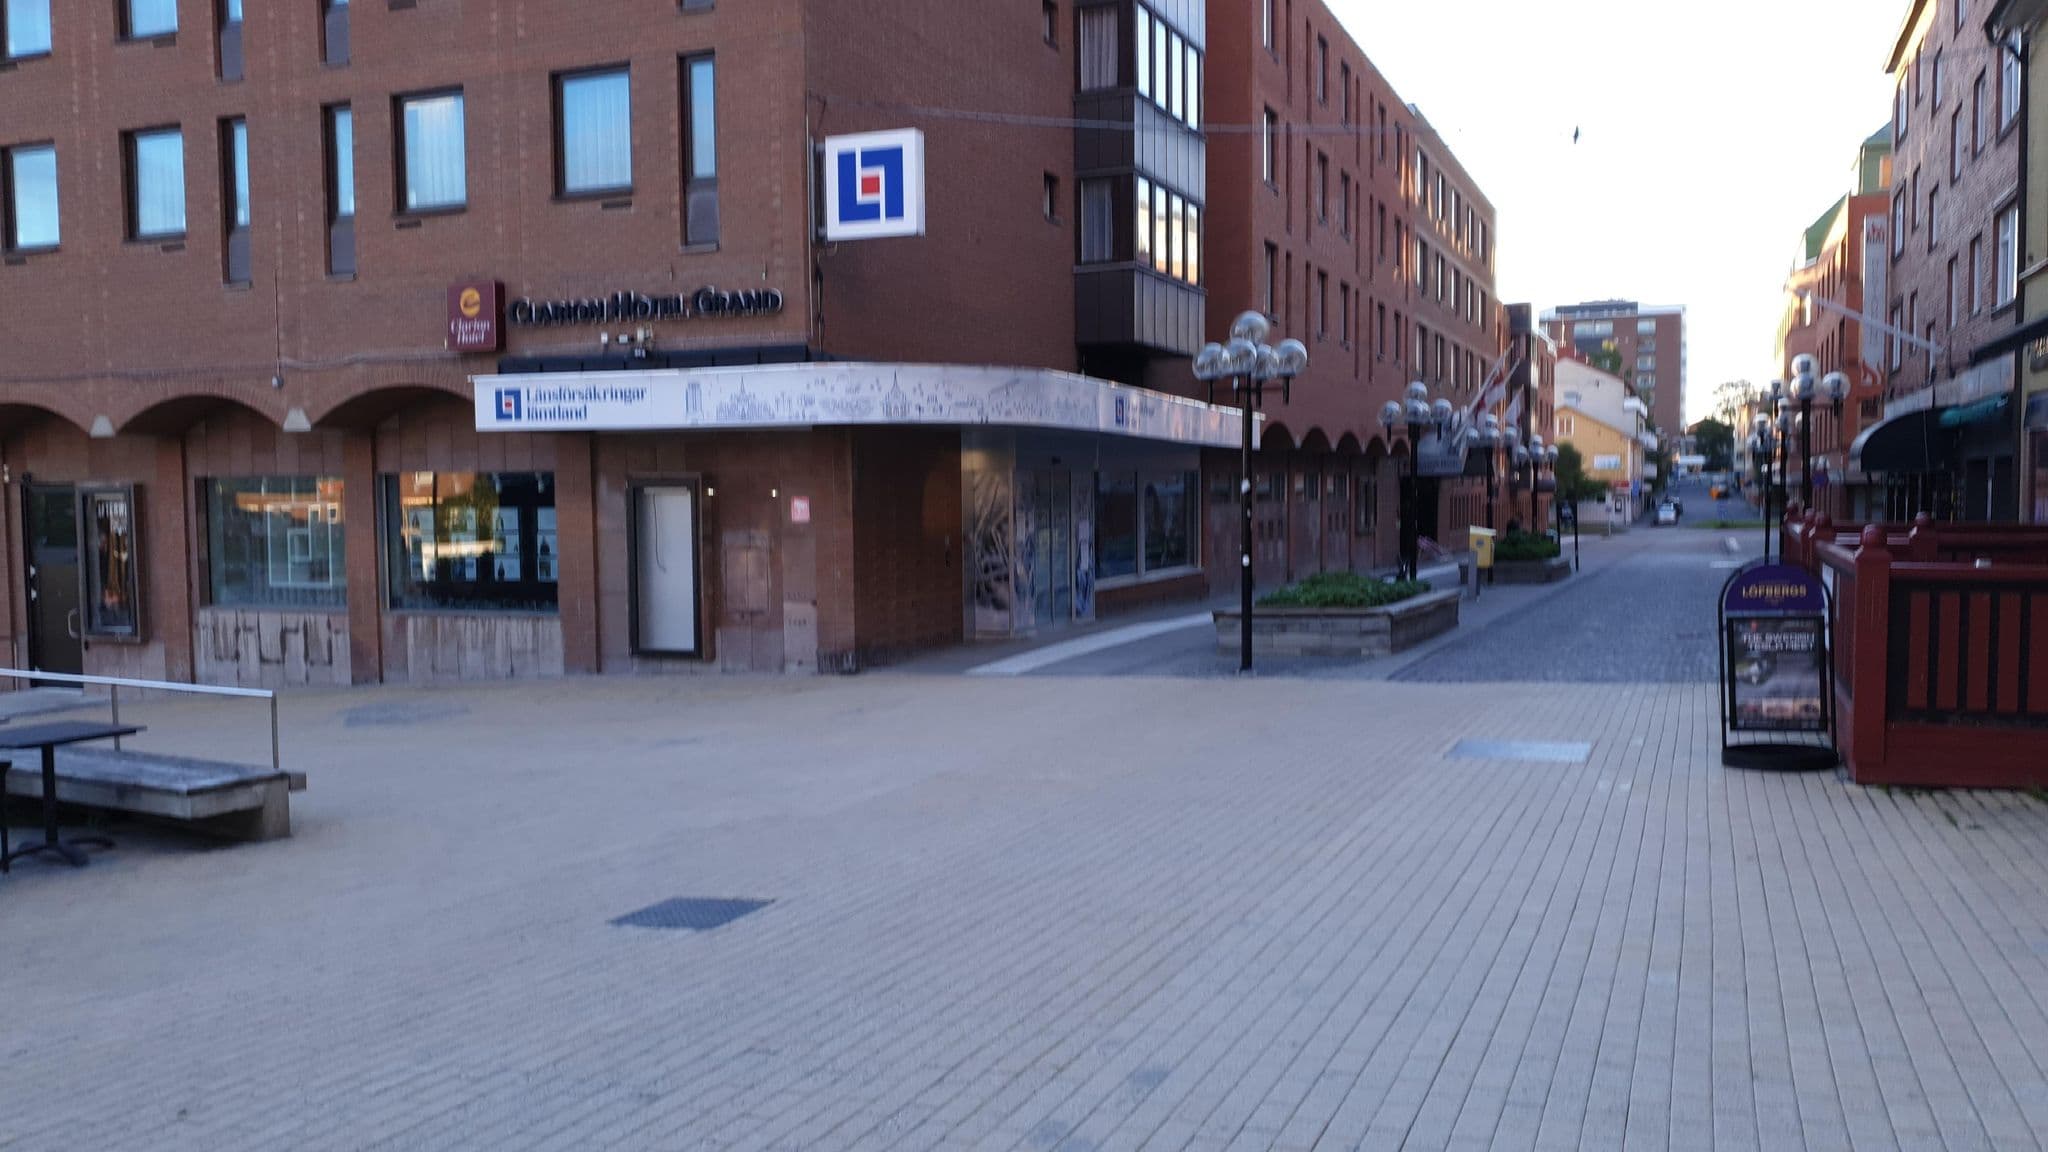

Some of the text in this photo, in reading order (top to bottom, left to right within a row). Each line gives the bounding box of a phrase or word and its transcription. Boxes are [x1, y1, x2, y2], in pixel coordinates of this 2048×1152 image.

[451, 317, 490, 334] Clarion
[457, 331, 485, 345] Hotel
[526, 384, 647, 405] Länsförsäkringar
[527, 404, 588, 422] Jämtland
[1742, 584, 1807, 598] LÖFBERGS
